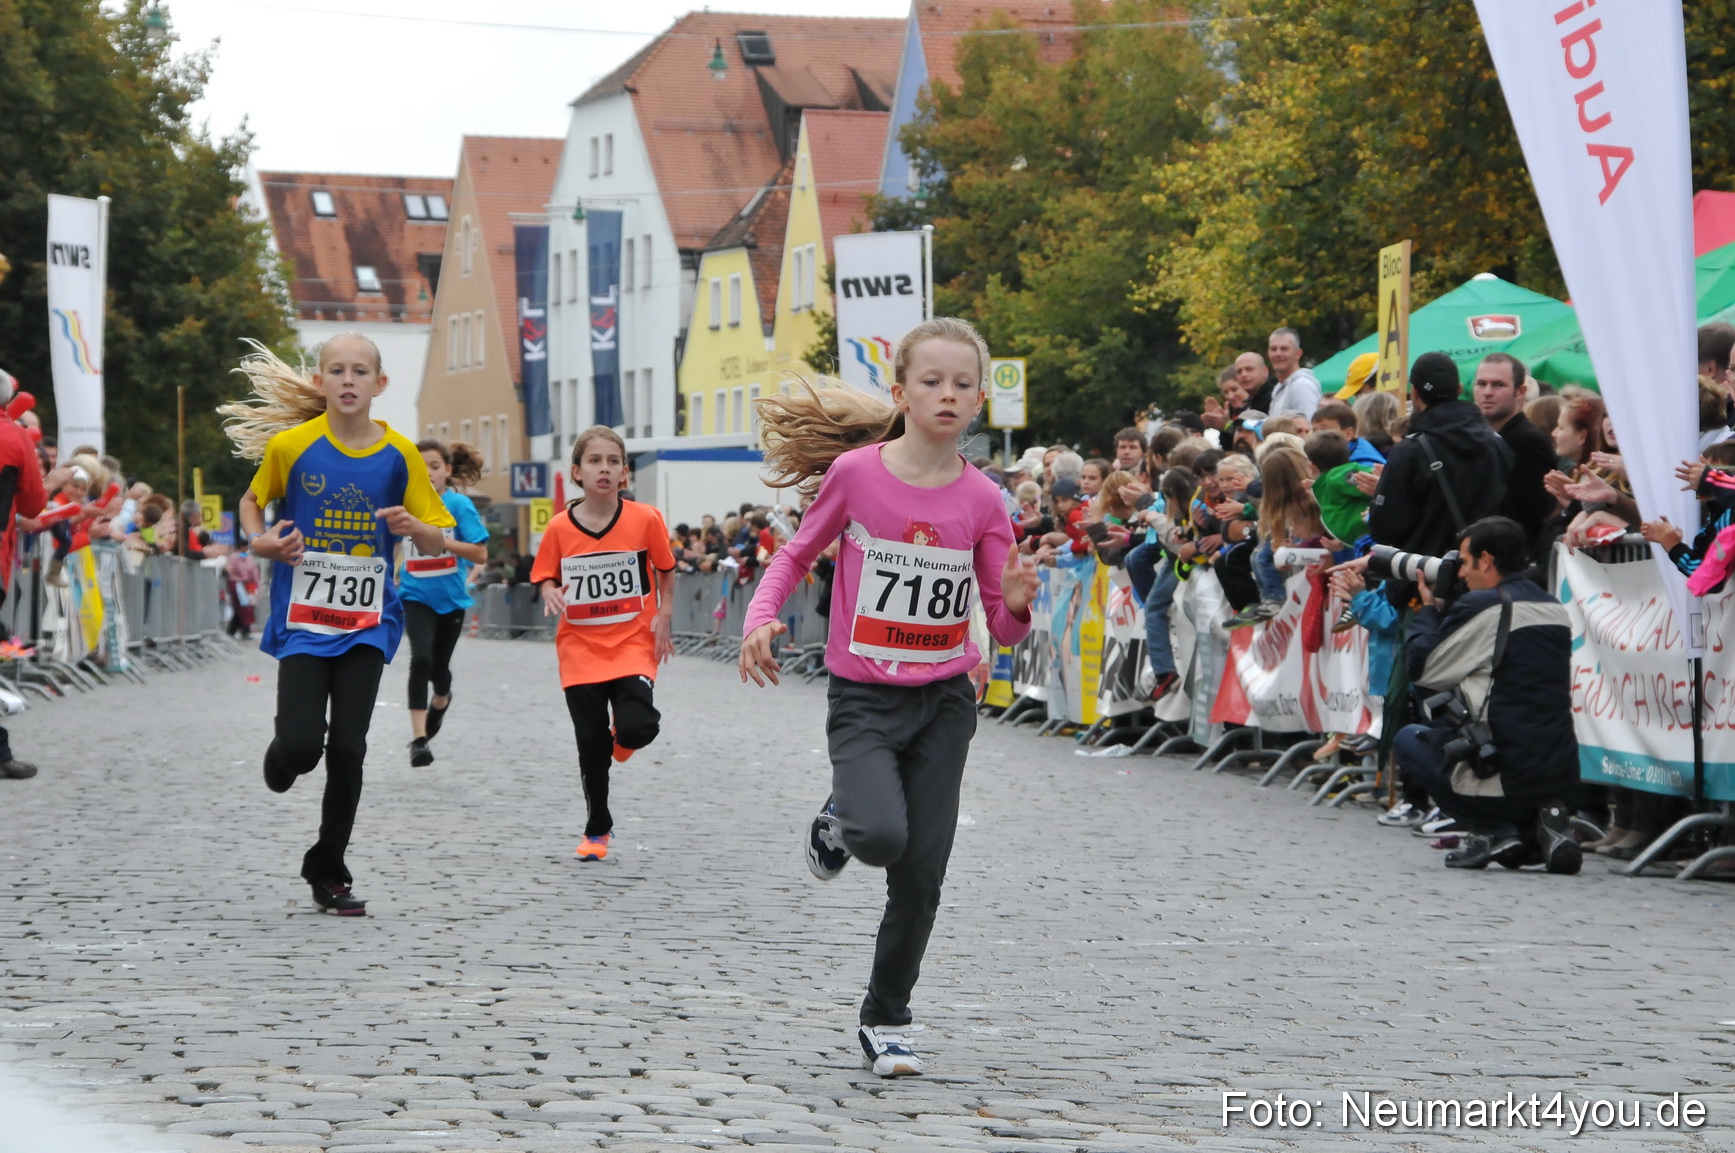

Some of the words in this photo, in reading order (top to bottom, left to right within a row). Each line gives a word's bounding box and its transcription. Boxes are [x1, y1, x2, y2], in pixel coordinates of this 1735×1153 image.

[1383, 252, 1401, 279] Bloc
[1384, 289, 1401, 360] A
[202, 506, 213, 522] D
[537, 509, 548, 526] D
[301, 560, 328, 569] ARTL
[329, 563, 371, 572] Neumarkt
[563, 564, 588, 572] PARTL
[589, 560, 625, 571] Neumarkt
[867, 549, 911, 567] PARTL
[913, 556, 971, 573] Neumarkt
[303, 571, 376, 608] 7130
[570, 568, 634, 601] 7039
[875, 569, 972, 620] 7180
[312, 610, 358, 627] Victoria
[590, 603, 620, 616] Marie
[886, 626, 949, 646] Theresa
